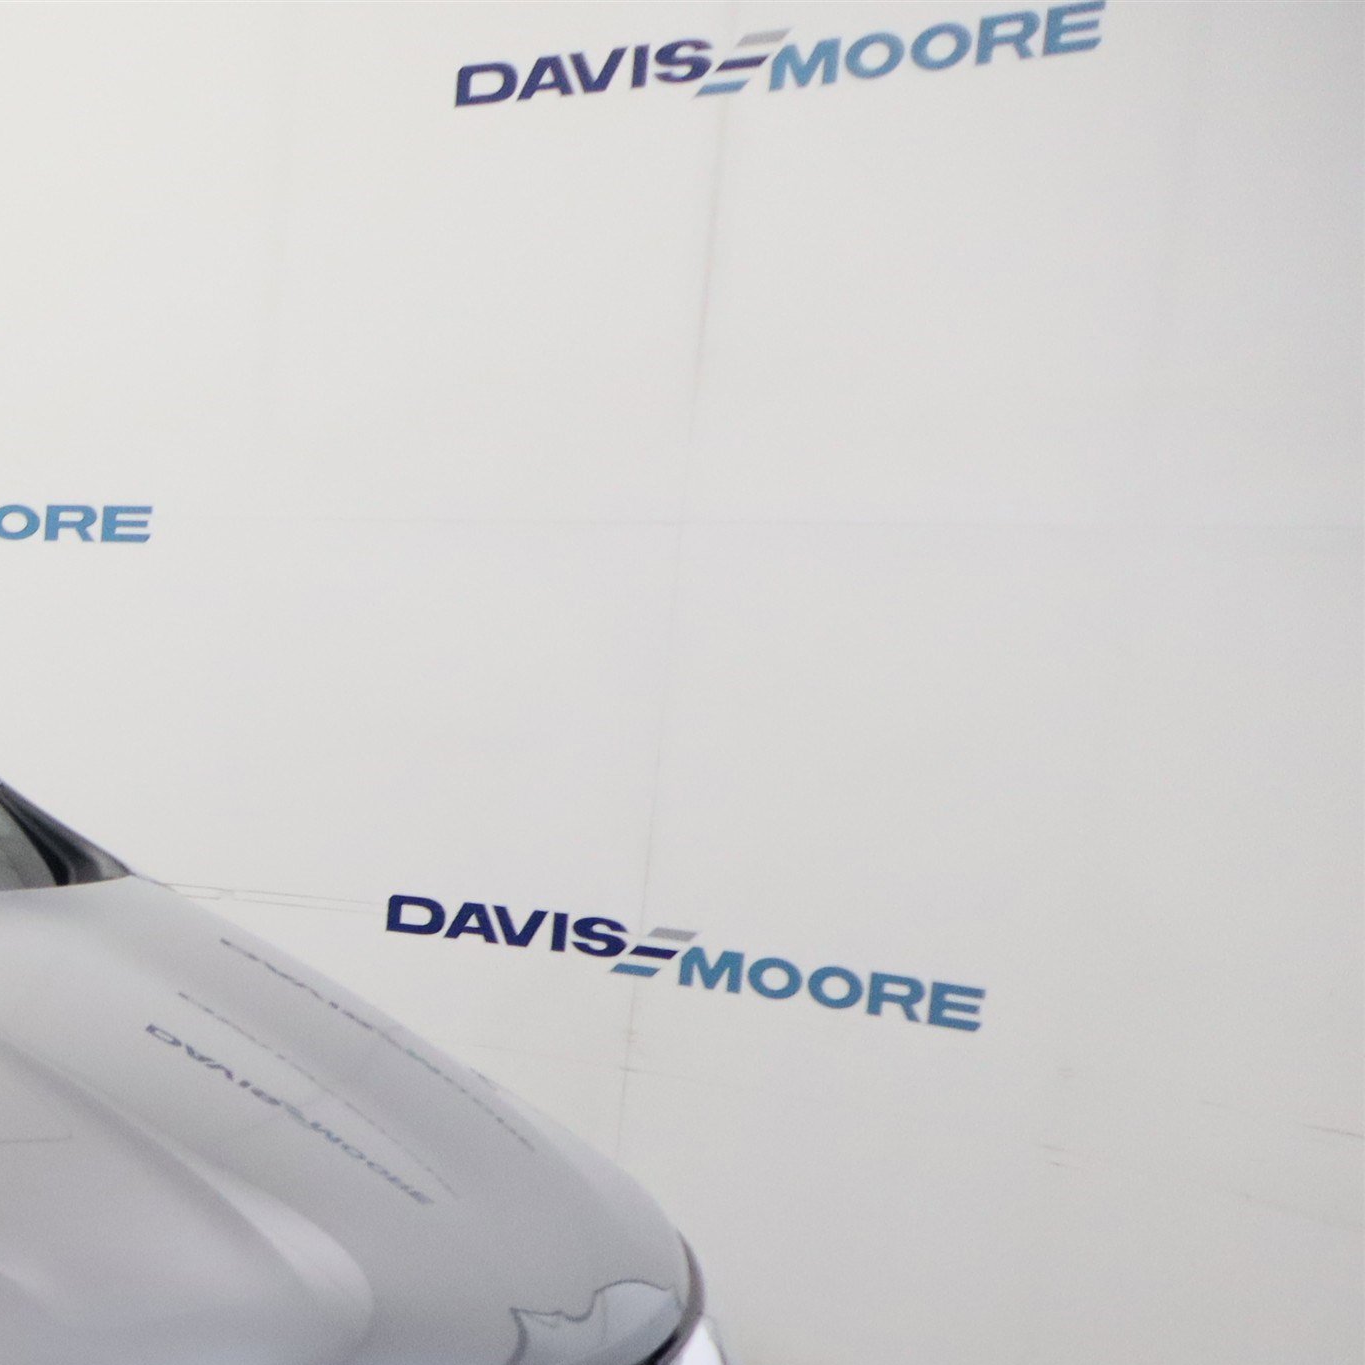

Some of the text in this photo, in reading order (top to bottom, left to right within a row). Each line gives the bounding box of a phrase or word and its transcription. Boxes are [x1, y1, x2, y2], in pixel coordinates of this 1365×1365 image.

[454, 0, 1106, 107] DAVIS MOORE
[386, 894, 986, 1031] DAVIS MOORE
